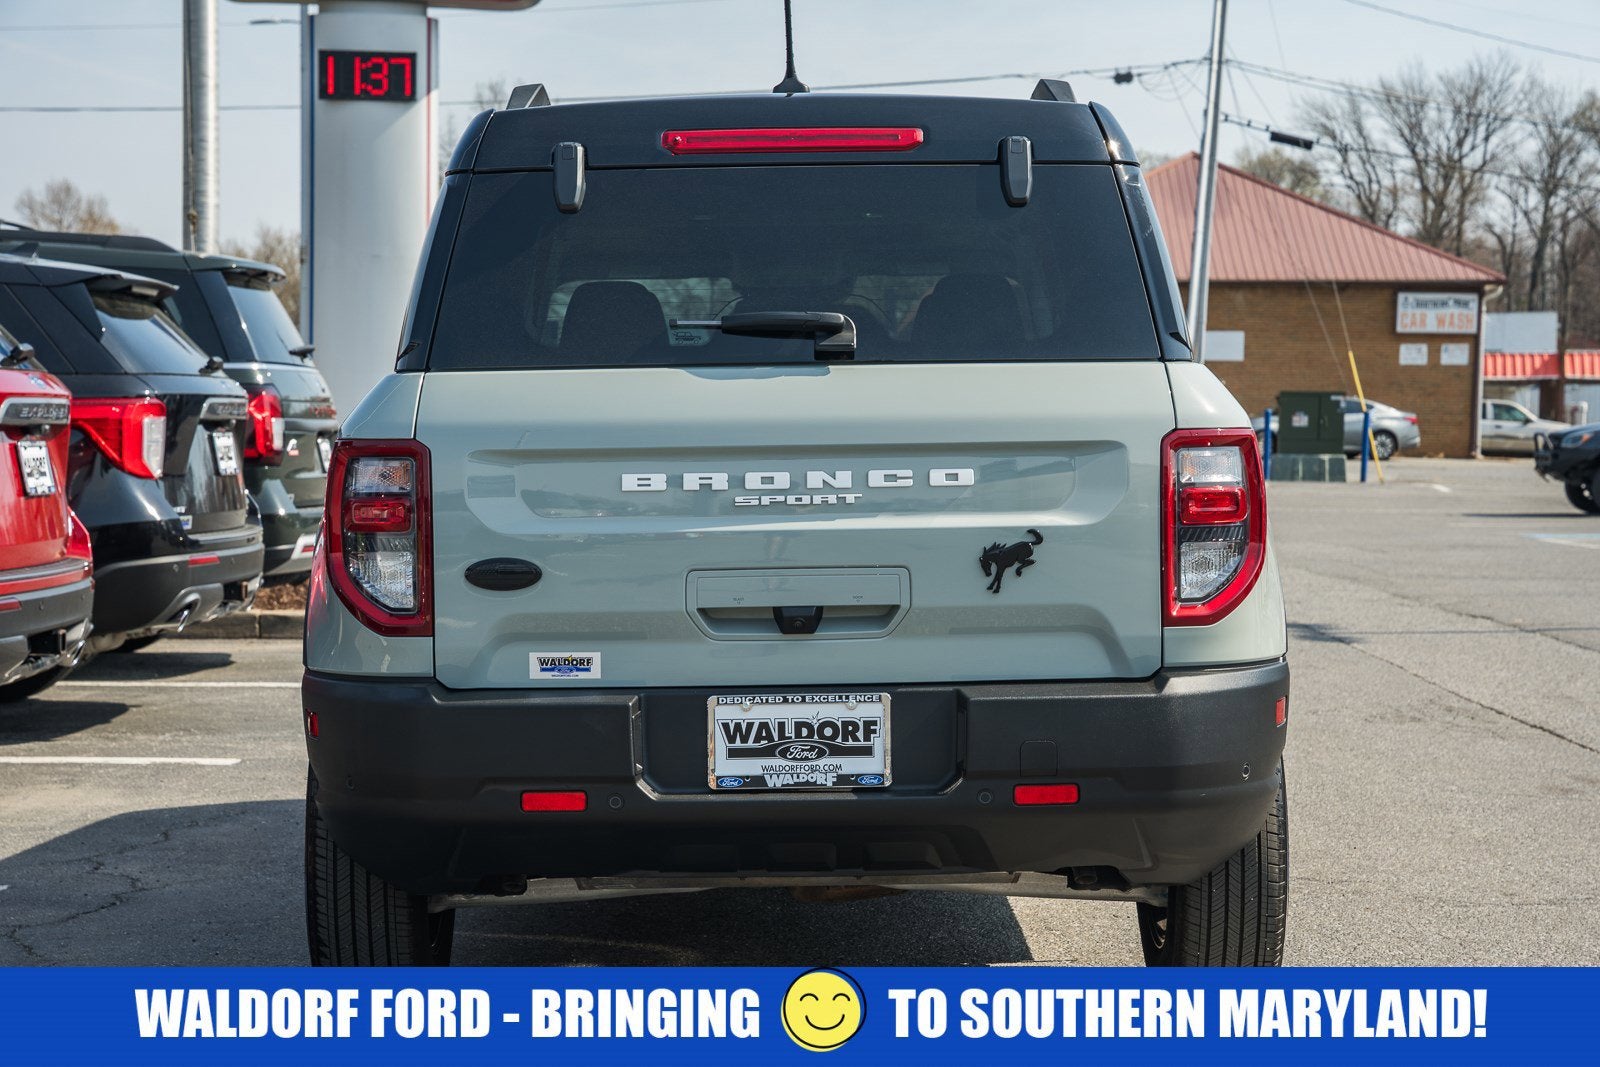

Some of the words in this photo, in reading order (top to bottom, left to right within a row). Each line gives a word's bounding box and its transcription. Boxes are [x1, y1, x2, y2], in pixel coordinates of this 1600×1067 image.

[1400, 312, 1428, 330] CAR
[1436, 312, 1475, 330] WASH
[622, 468, 975, 492] BRONCO
[734, 494, 863, 506] SPORT
[538, 657, 593, 667] WALDORF
[718, 696, 784, 704] DEDICATED
[786, 695, 802, 703] TO
[805, 694, 880, 703] EXCELLENCE
[719, 718, 880, 745] WALDORF
[786, 745, 819, 759] Ford
[761, 763, 843, 773] WALDORFFORD.COM
[763, 772, 838, 787] WALDORF
